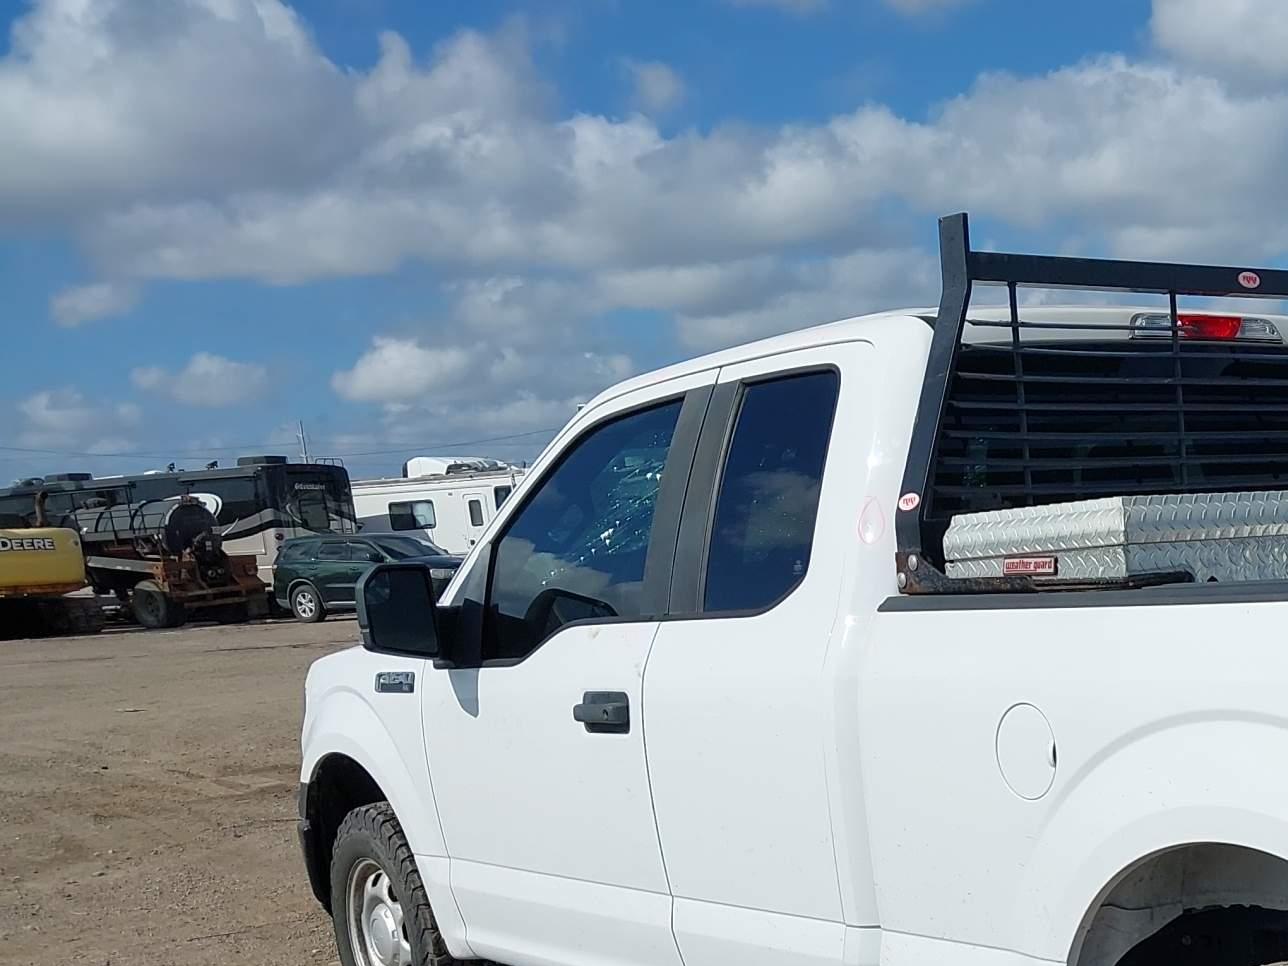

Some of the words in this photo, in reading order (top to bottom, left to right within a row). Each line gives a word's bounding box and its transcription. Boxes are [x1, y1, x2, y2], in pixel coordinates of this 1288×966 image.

[0, 537, 55, 551] DEERE
[1005, 559, 1032, 569] weather
[1034, 559, 1053, 571] guard
